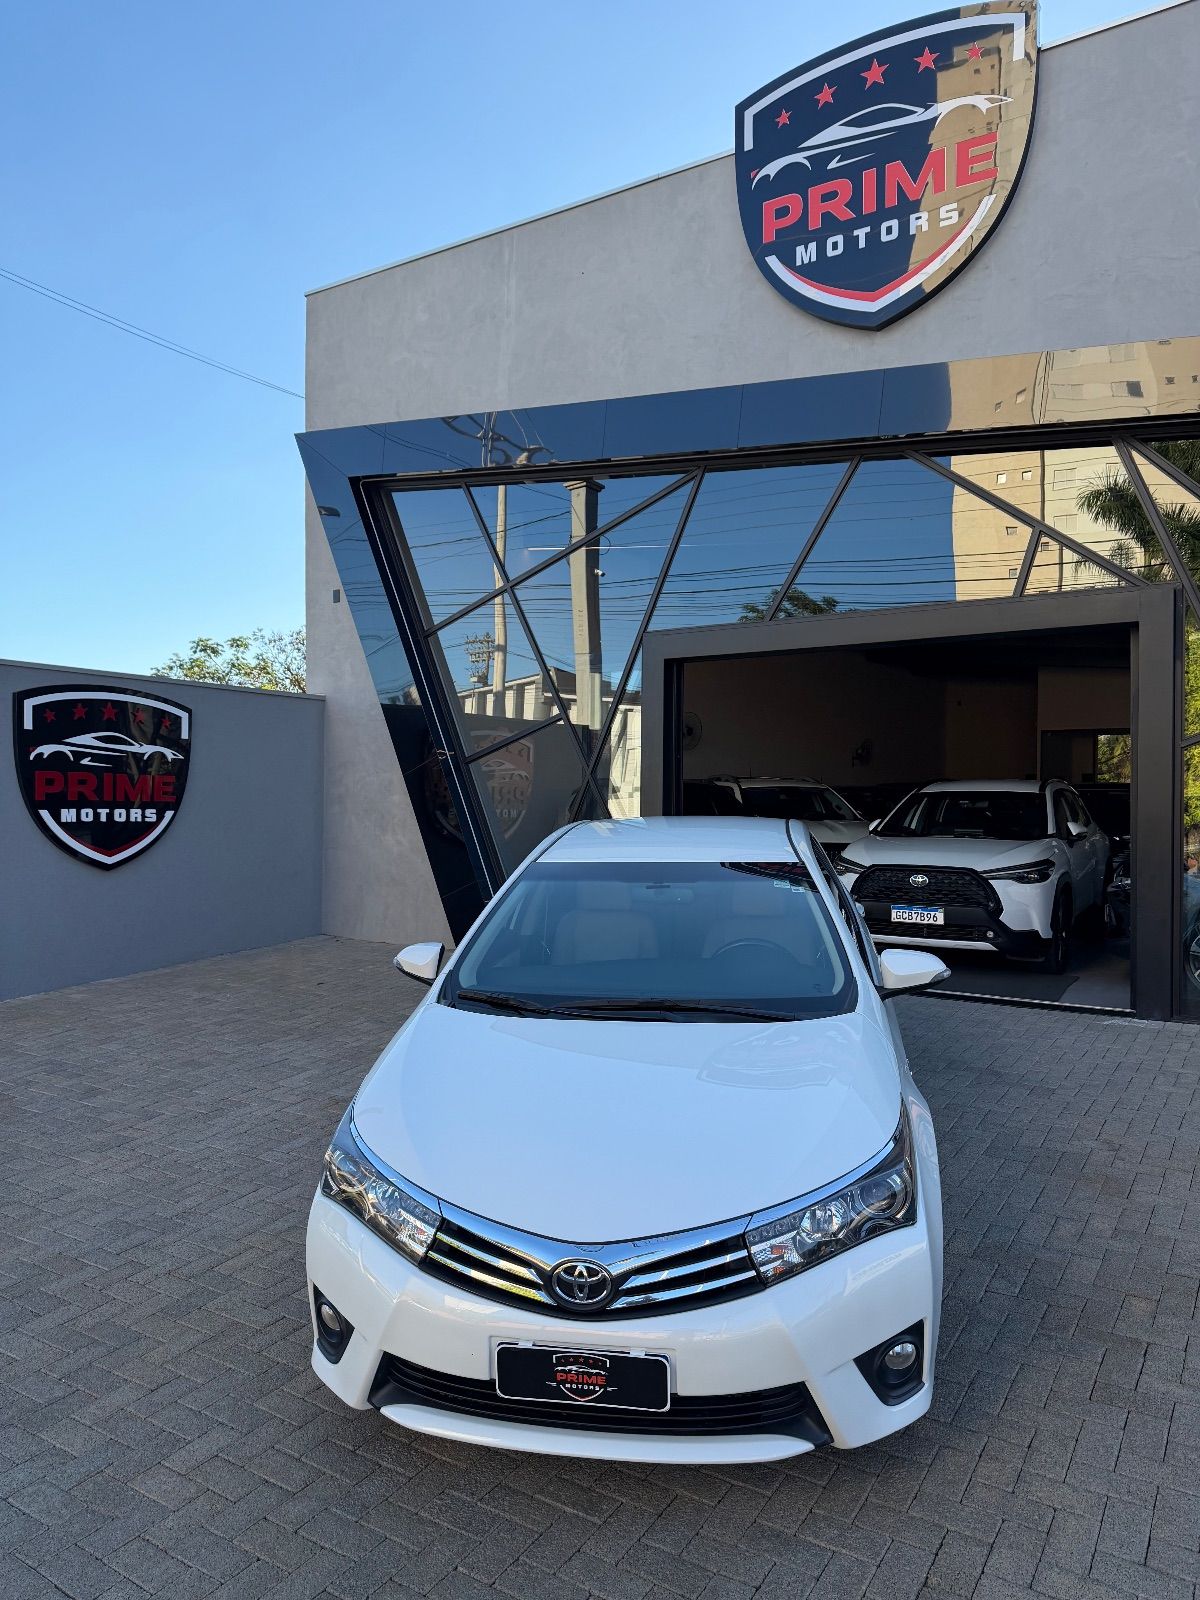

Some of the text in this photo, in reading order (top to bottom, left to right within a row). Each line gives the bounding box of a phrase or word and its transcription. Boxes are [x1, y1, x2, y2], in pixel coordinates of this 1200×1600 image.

[762, 131, 999, 244] PRIME
[795, 202, 959, 267] MOTORS
[34, 770, 177, 803] PRIME
[60, 808, 157, 823] MOTORS
[895, 910, 939, 923] GCB7B96
[556, 1372, 607, 1385] PRIME
[565, 1383, 600, 1391] MOTORS
